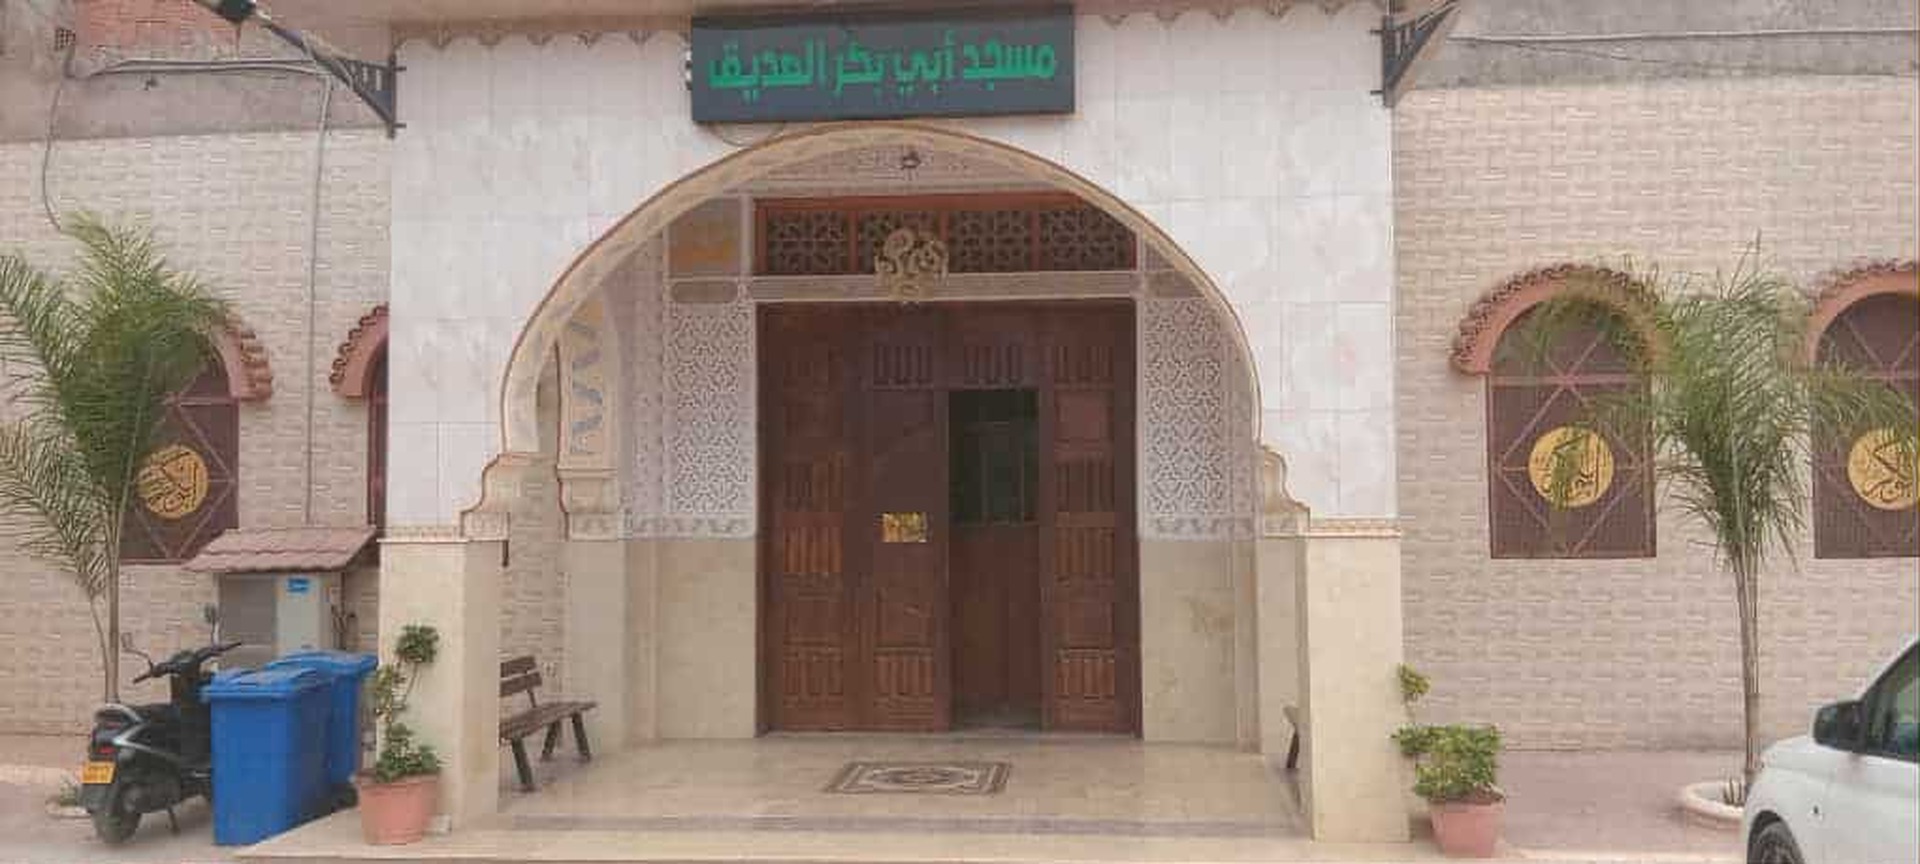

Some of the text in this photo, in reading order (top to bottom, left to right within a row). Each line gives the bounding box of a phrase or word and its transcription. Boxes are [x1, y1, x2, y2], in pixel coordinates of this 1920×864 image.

[834, 32, 885, 97] بكر
[891, 29, 956, 97] أبي
[962, 39, 1056, 91] مسجد
